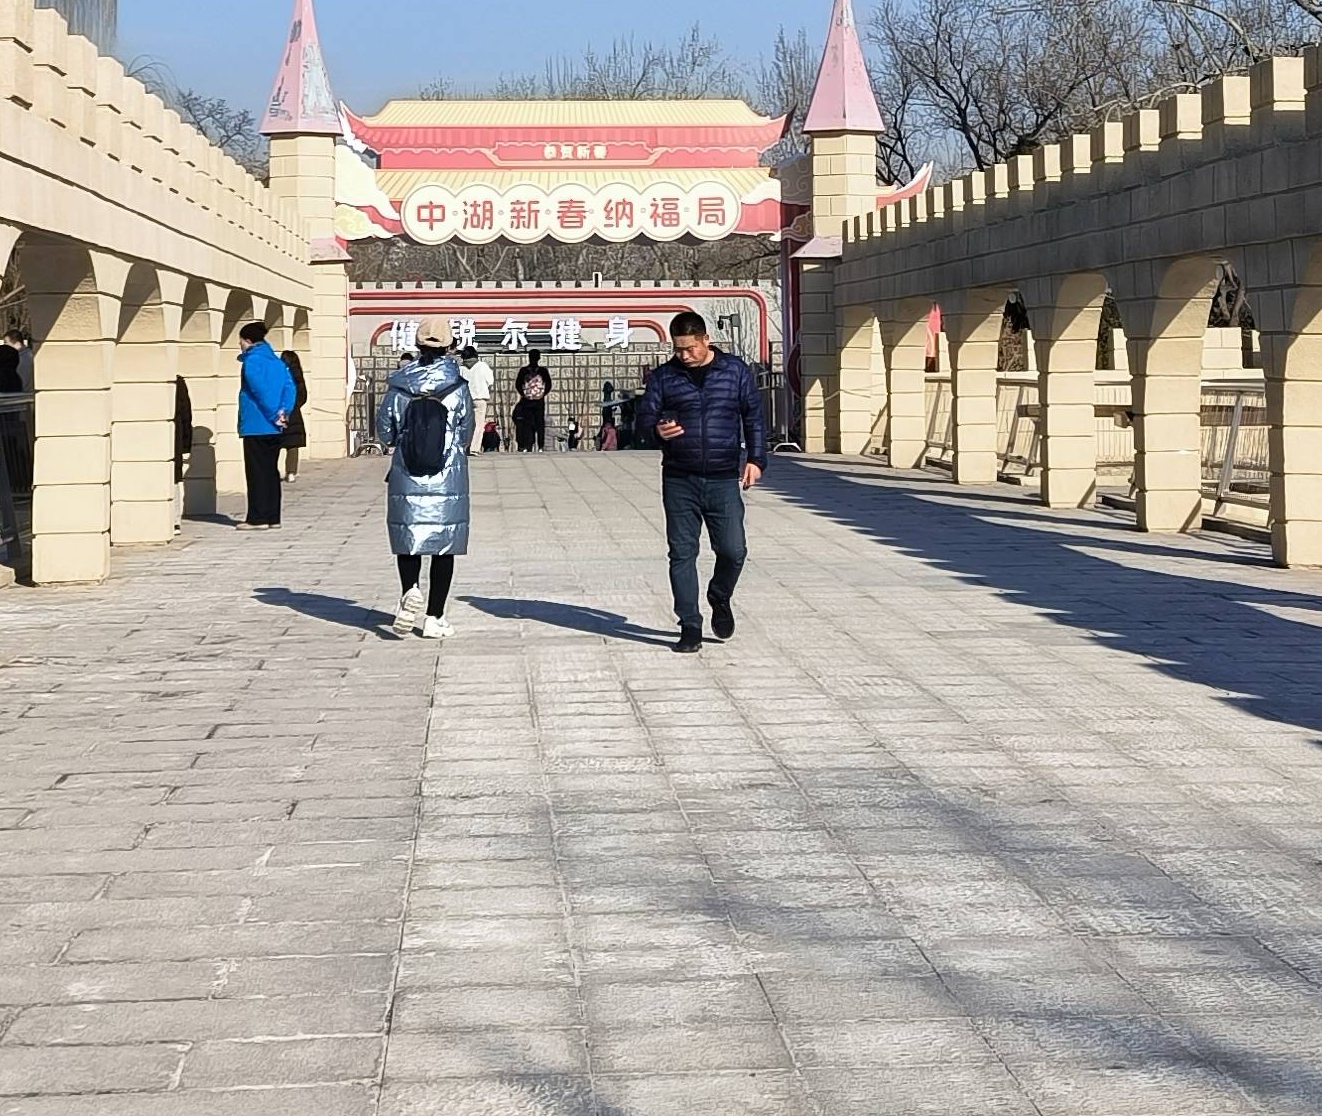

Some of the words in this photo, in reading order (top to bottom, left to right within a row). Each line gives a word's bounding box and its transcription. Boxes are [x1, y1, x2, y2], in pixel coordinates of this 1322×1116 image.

[416, 196, 727, 231] 中湖新春纳福局
